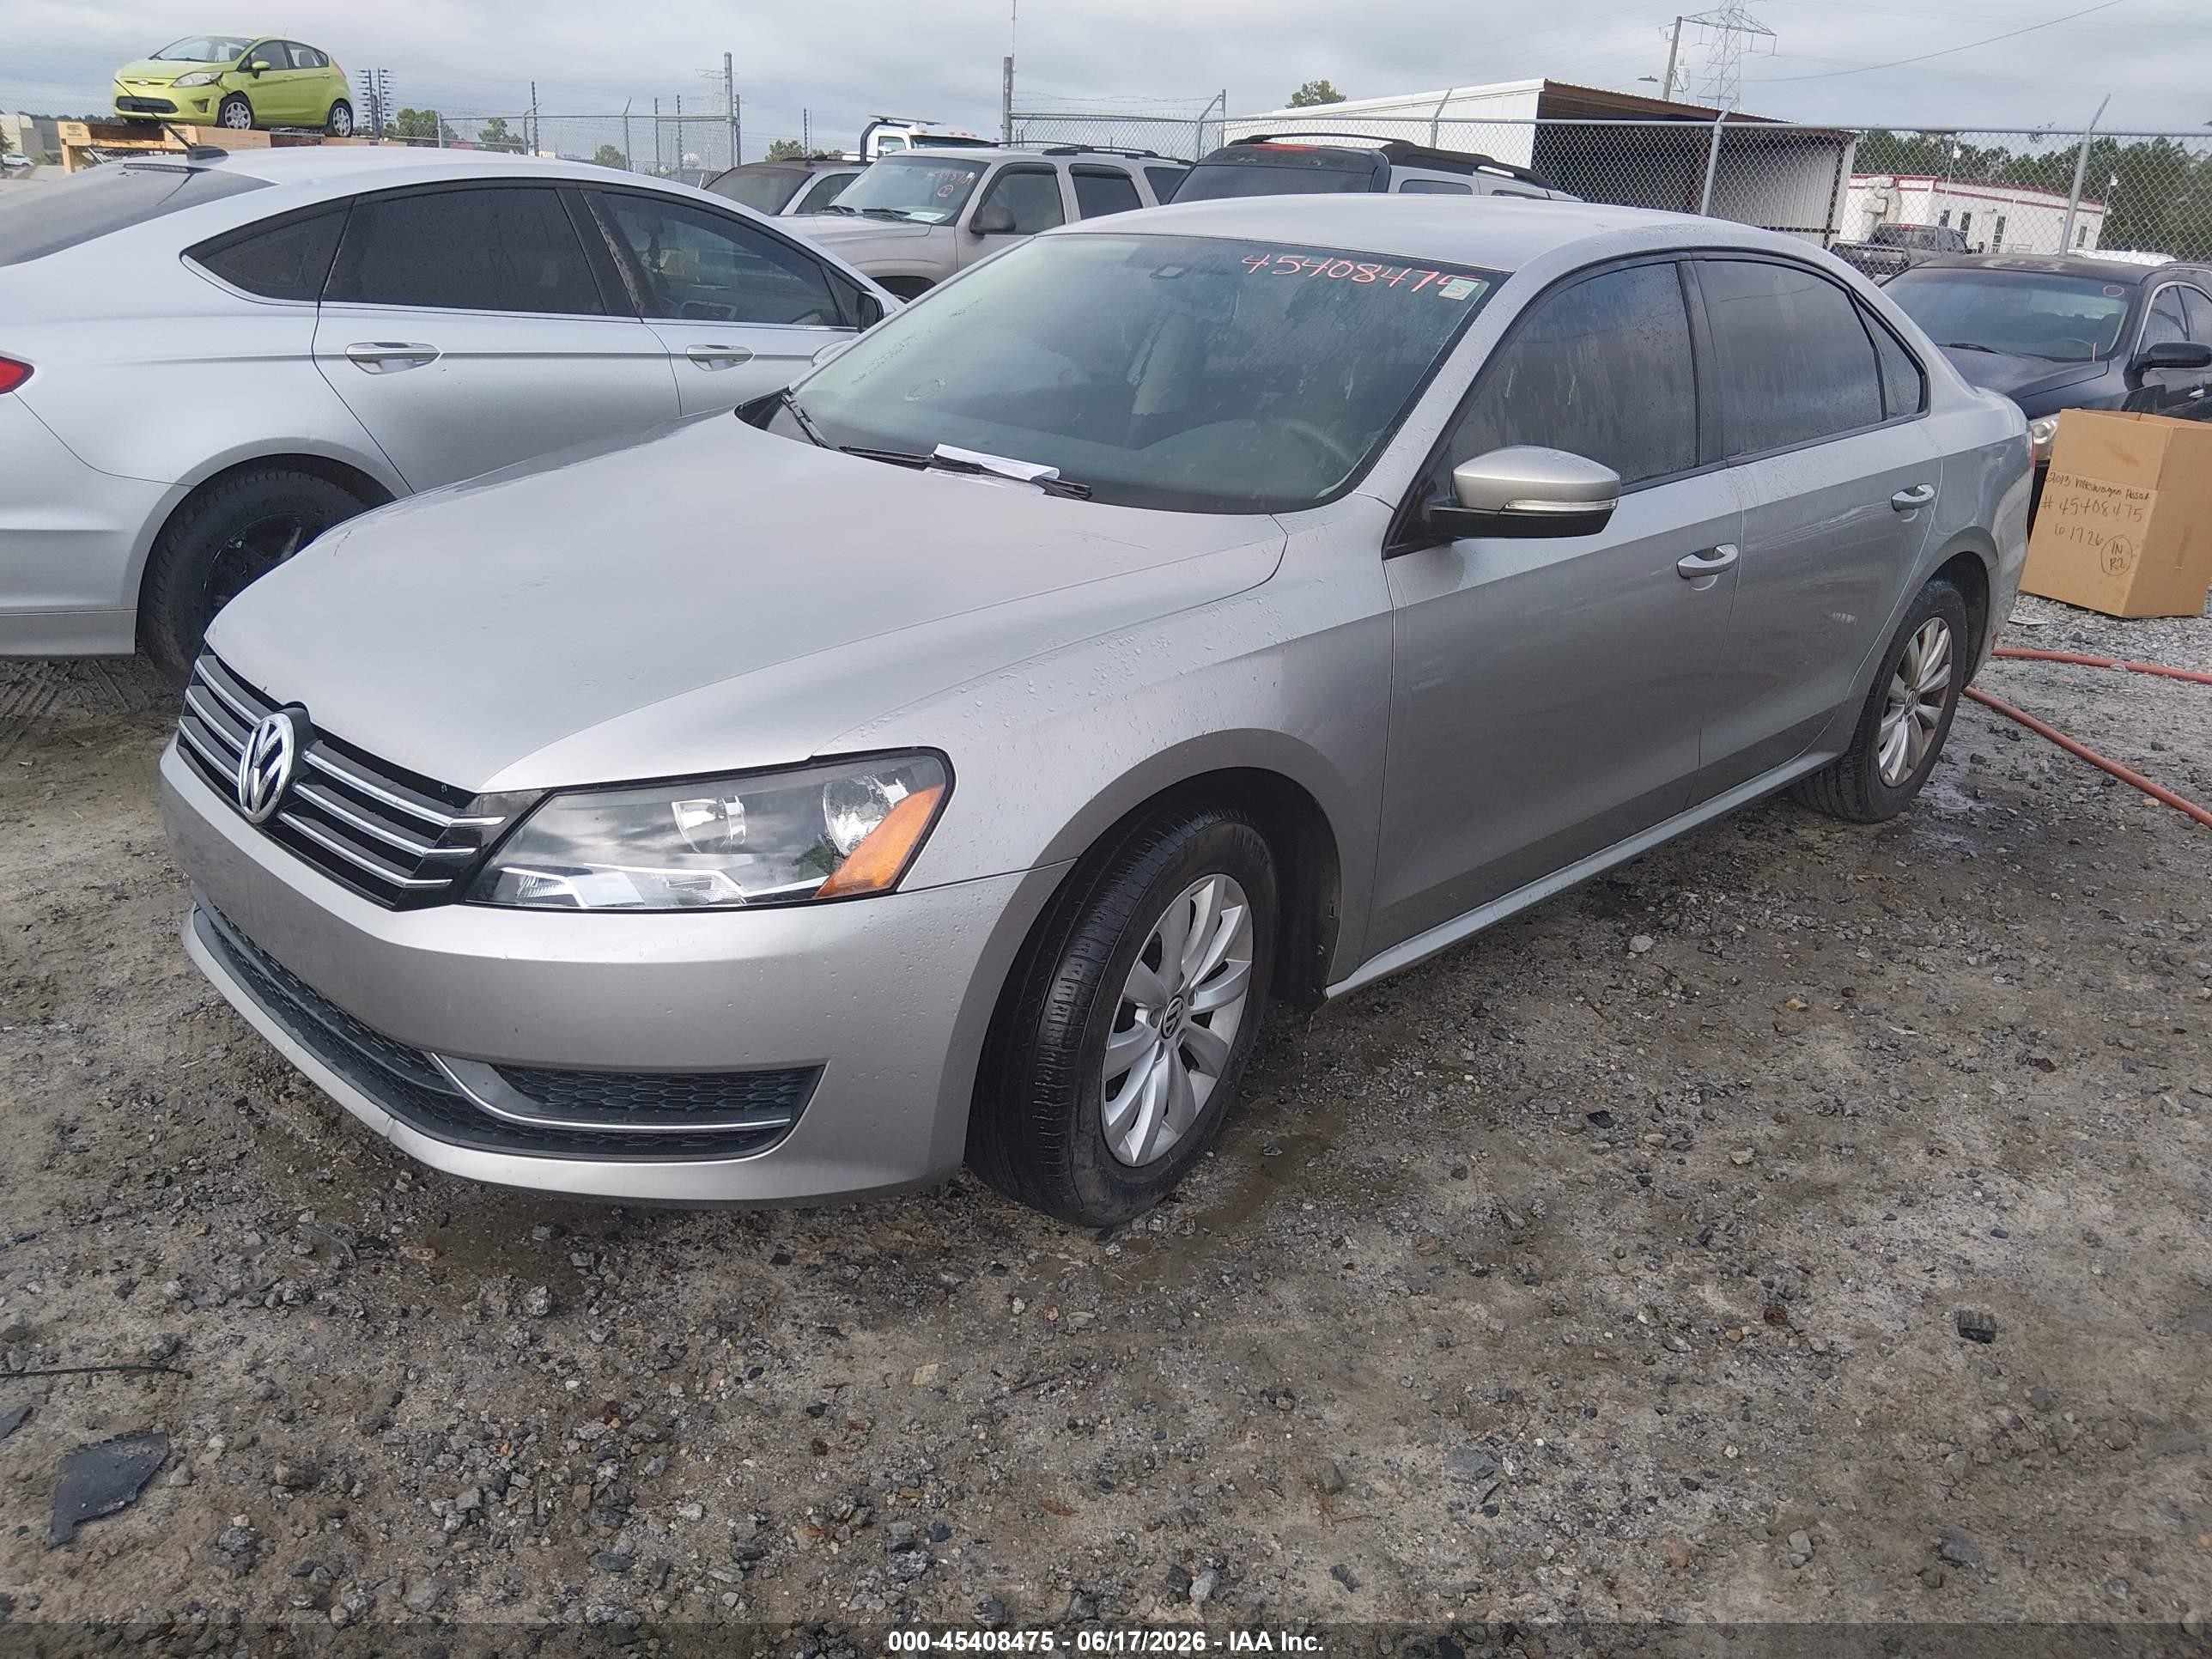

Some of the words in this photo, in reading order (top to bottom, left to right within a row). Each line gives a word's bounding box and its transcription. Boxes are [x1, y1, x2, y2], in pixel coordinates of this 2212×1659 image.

[1242, 254, 1483, 300] 45408475
[2045, 471, 2070, 486] 2013
[2040, 495, 2054, 509] #
[2059, 496, 2144, 522] 45408475
